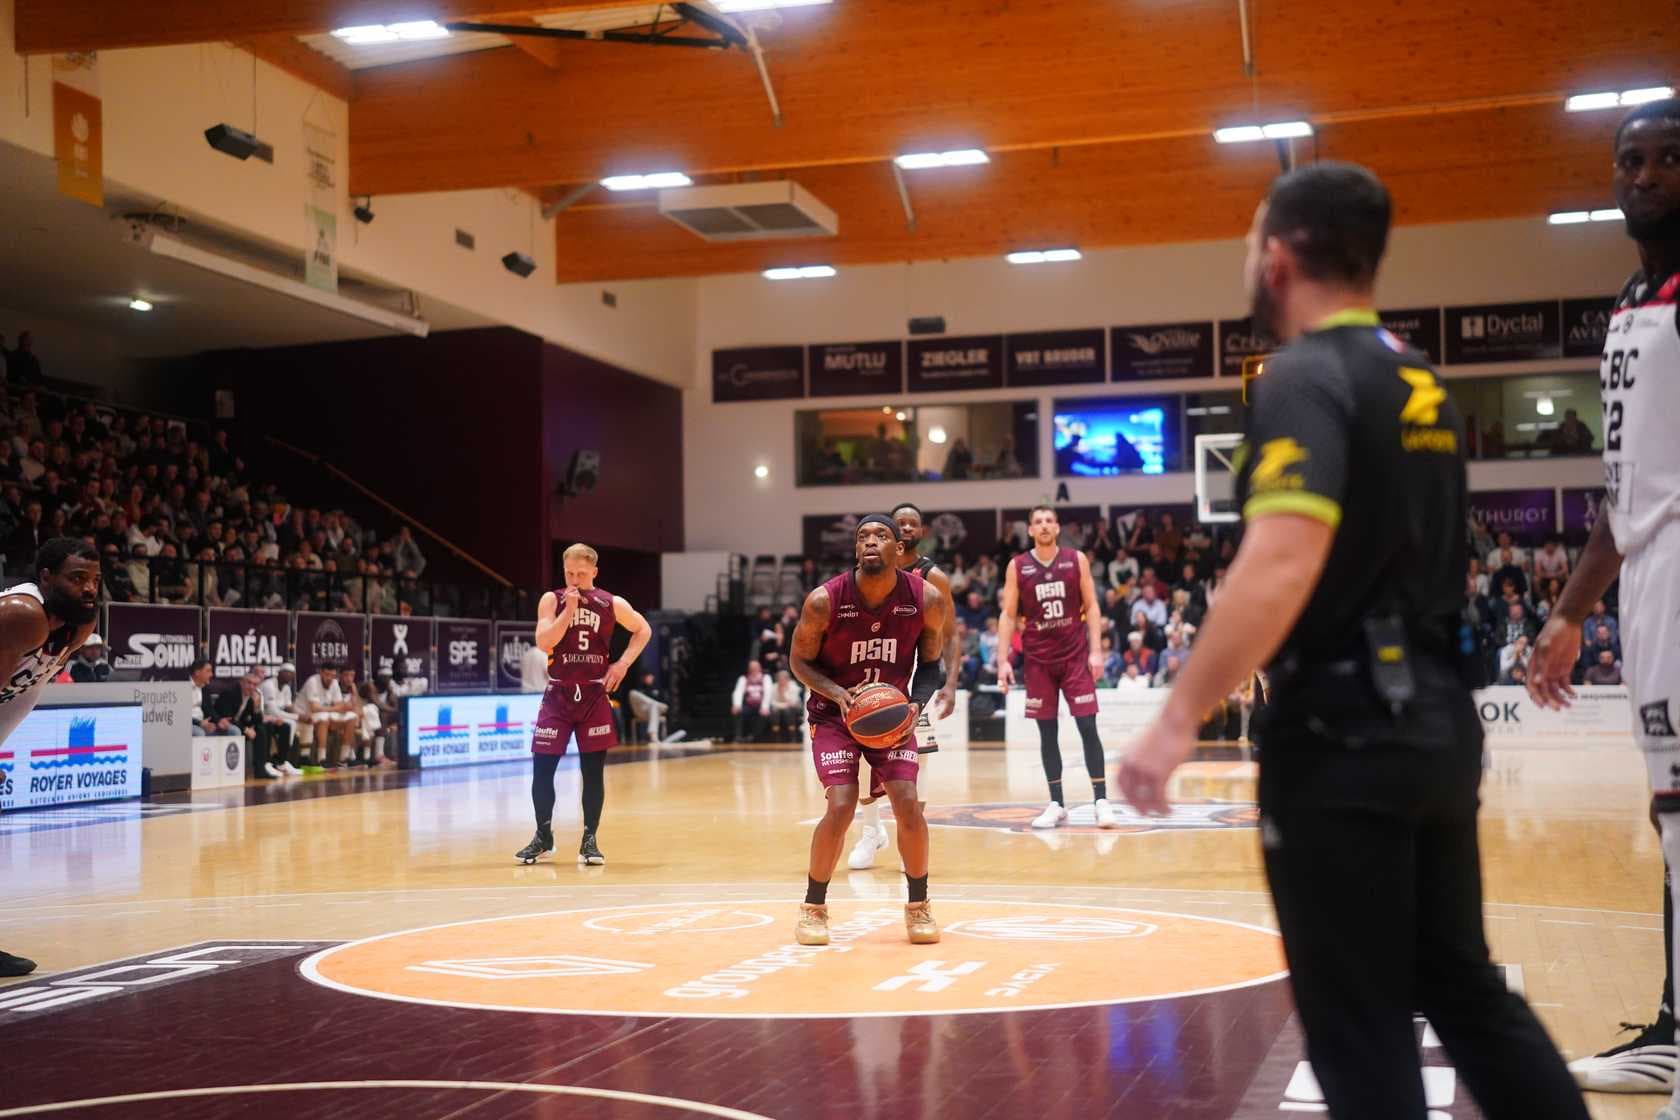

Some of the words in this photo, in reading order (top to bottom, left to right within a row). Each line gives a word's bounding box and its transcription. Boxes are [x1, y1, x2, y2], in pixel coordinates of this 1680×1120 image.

[1487, 313, 1543, 336] Dyctal
[824, 352, 886, 370] MUTLU
[1056, 482, 1070, 501] A
[1036, 581, 1066, 601] ASA
[1041, 600, 1064, 620] 30
[215, 628, 284, 665] ARÉAL
[312, 642, 349, 658] L'EDEN
[578, 631, 590, 650] 5
[114, 633, 196, 669] SOHM
[449, 641, 478, 665] SPE
[850, 638, 897, 665] ASA
[134, 689, 178, 704] Parquets
[142, 708, 174, 726] udwig
[30, 774, 73, 792] ROYER
[77, 770, 127, 788] VOYAGES
